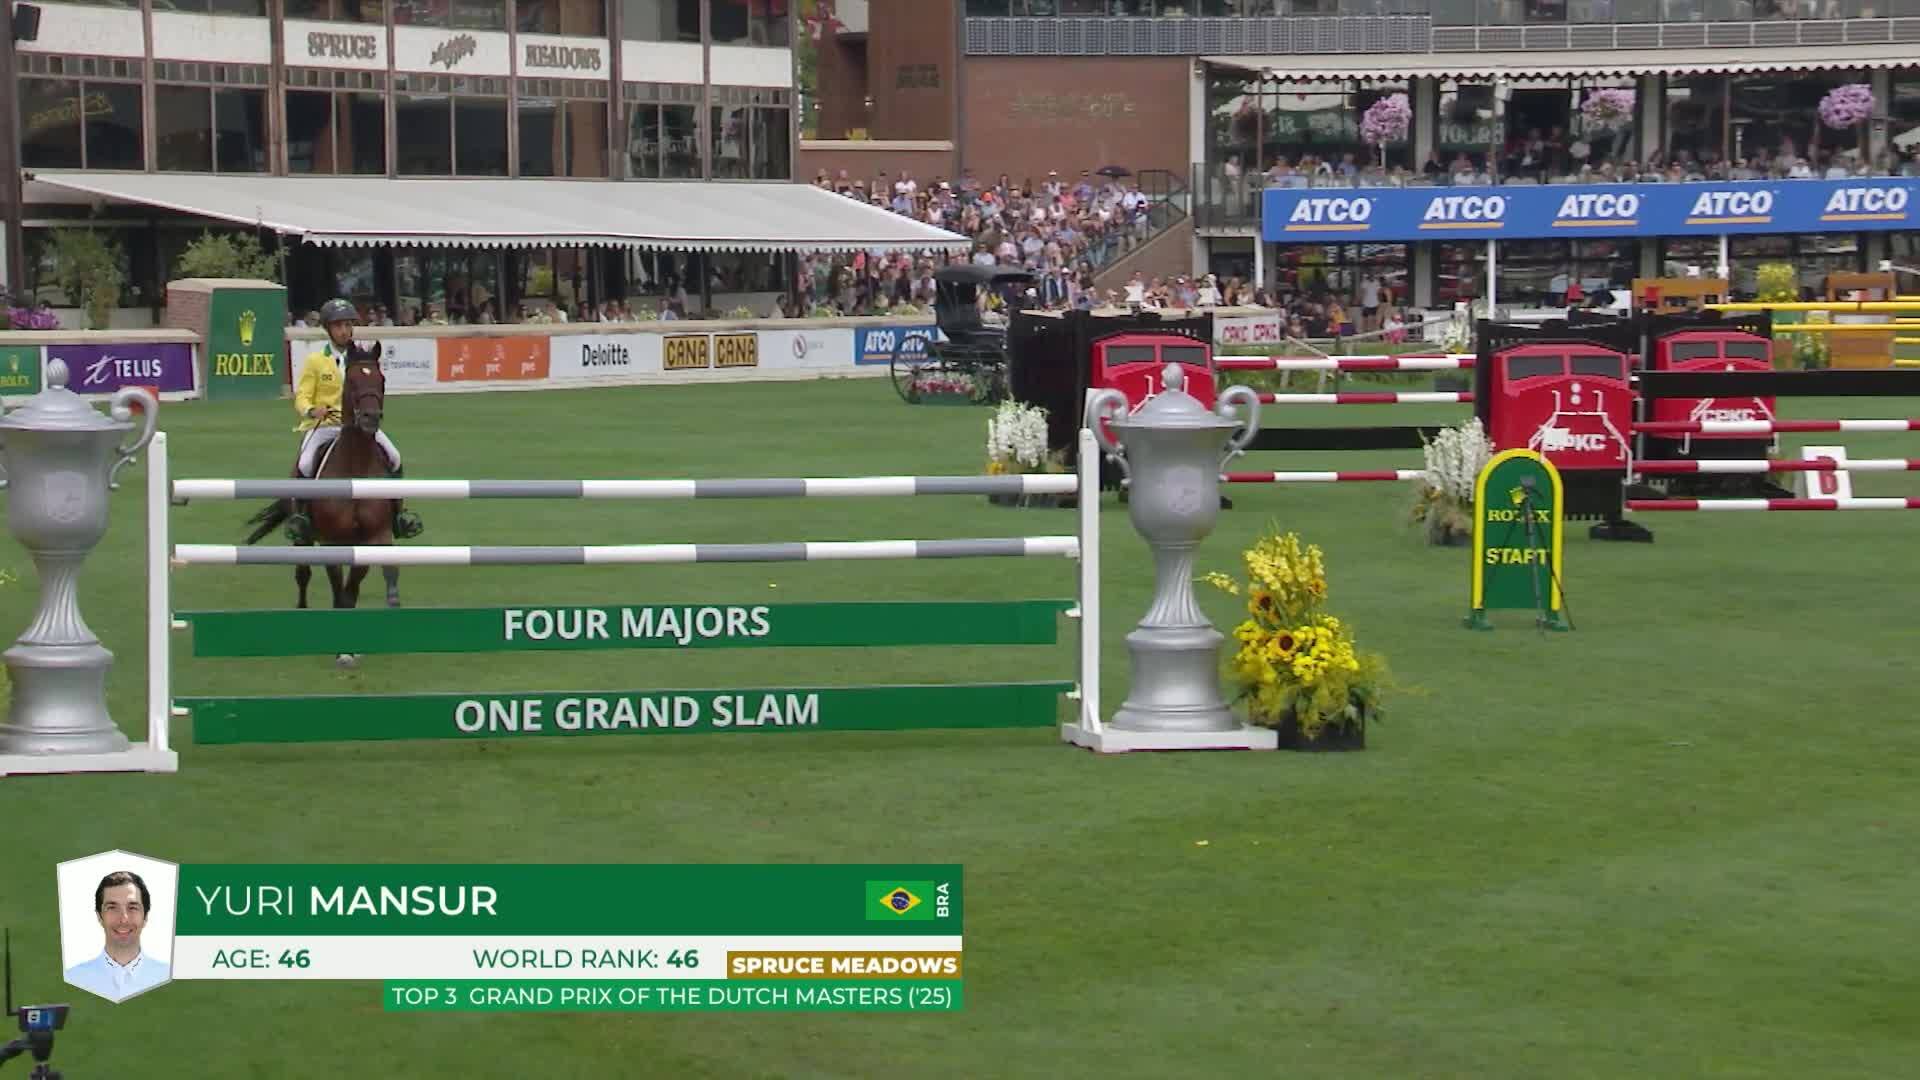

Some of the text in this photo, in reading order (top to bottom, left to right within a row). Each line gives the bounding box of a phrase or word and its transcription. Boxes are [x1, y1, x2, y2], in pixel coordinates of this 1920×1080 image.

[307, 31, 602, 71] SPRUCE MEADOWS
[1289, 197, 1372, 222] ATCO
[1423, 195, 1505, 221] ATCO
[1557, 193, 1639, 218] ATCO
[1690, 190, 1773, 216] ATCO
[1825, 187, 1908, 212] ATCO
[666, 337, 755, 366] CANA CANA
[864, 330, 896, 352] ATCO
[114, 359, 162, 378] TELUS
[215, 353, 274, 376] ROLEX
[504, 606, 771, 645] FOUR MAJORS
[455, 693, 820, 732] ONE GRAND SLAM
